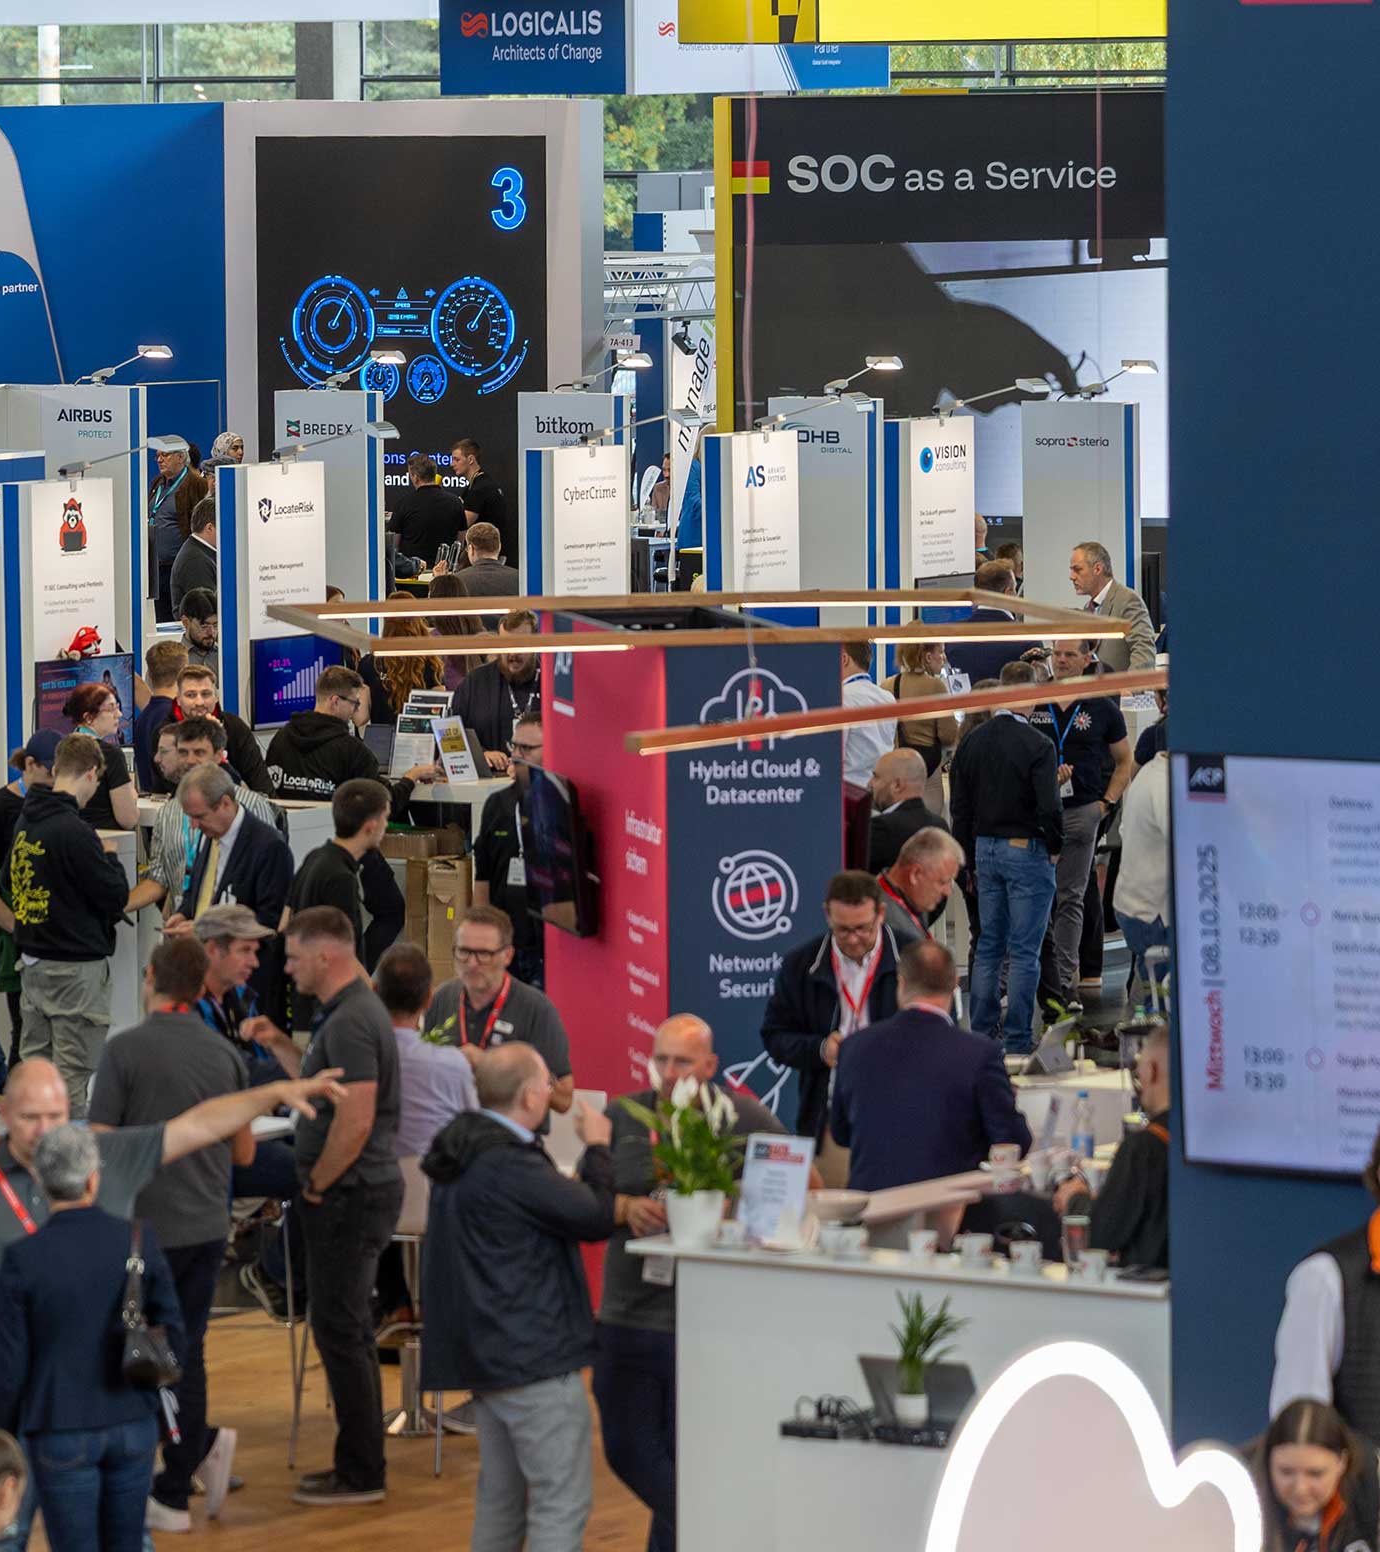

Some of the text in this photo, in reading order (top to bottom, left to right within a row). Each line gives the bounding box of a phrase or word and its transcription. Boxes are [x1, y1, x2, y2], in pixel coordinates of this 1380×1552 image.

[491, 9, 602, 37] LOGICALIS
[492, 43, 603, 63] Architects of Change
[787, 154, 1116, 193] SOC as a Service
[491, 167, 526, 230] 3
[2, 282, 39, 297] partner
[609, 338, 634, 347] 7A-413
[57, 408, 113, 424] AIRBUS
[535, 416, 595, 435] bitkom
[77, 430, 113, 440] PROTECT
[304, 423, 354, 436] BREDEX
[820, 446, 853, 454] DIGITAL
[934, 444, 967, 460] VISION
[1035, 436, 1110, 449] sopra steria
[935, 460, 967, 473] consulting
[384, 472, 410, 486] and
[745, 465, 766, 489] AS
[563, 486, 617, 506] CyberCrime
[274, 500, 315, 516] LocateRisk
[689, 757, 821, 785] Hybrid Cloud &
[284, 773, 336, 791] LocaeRisk
[706, 785, 804, 805] Datacenter
[1197, 844, 1223, 978] 08.10.2025
[709, 952, 784, 974] Network
[720, 977, 775, 999] Securi
[1206, 990, 1224, 1092] Mittwoch
